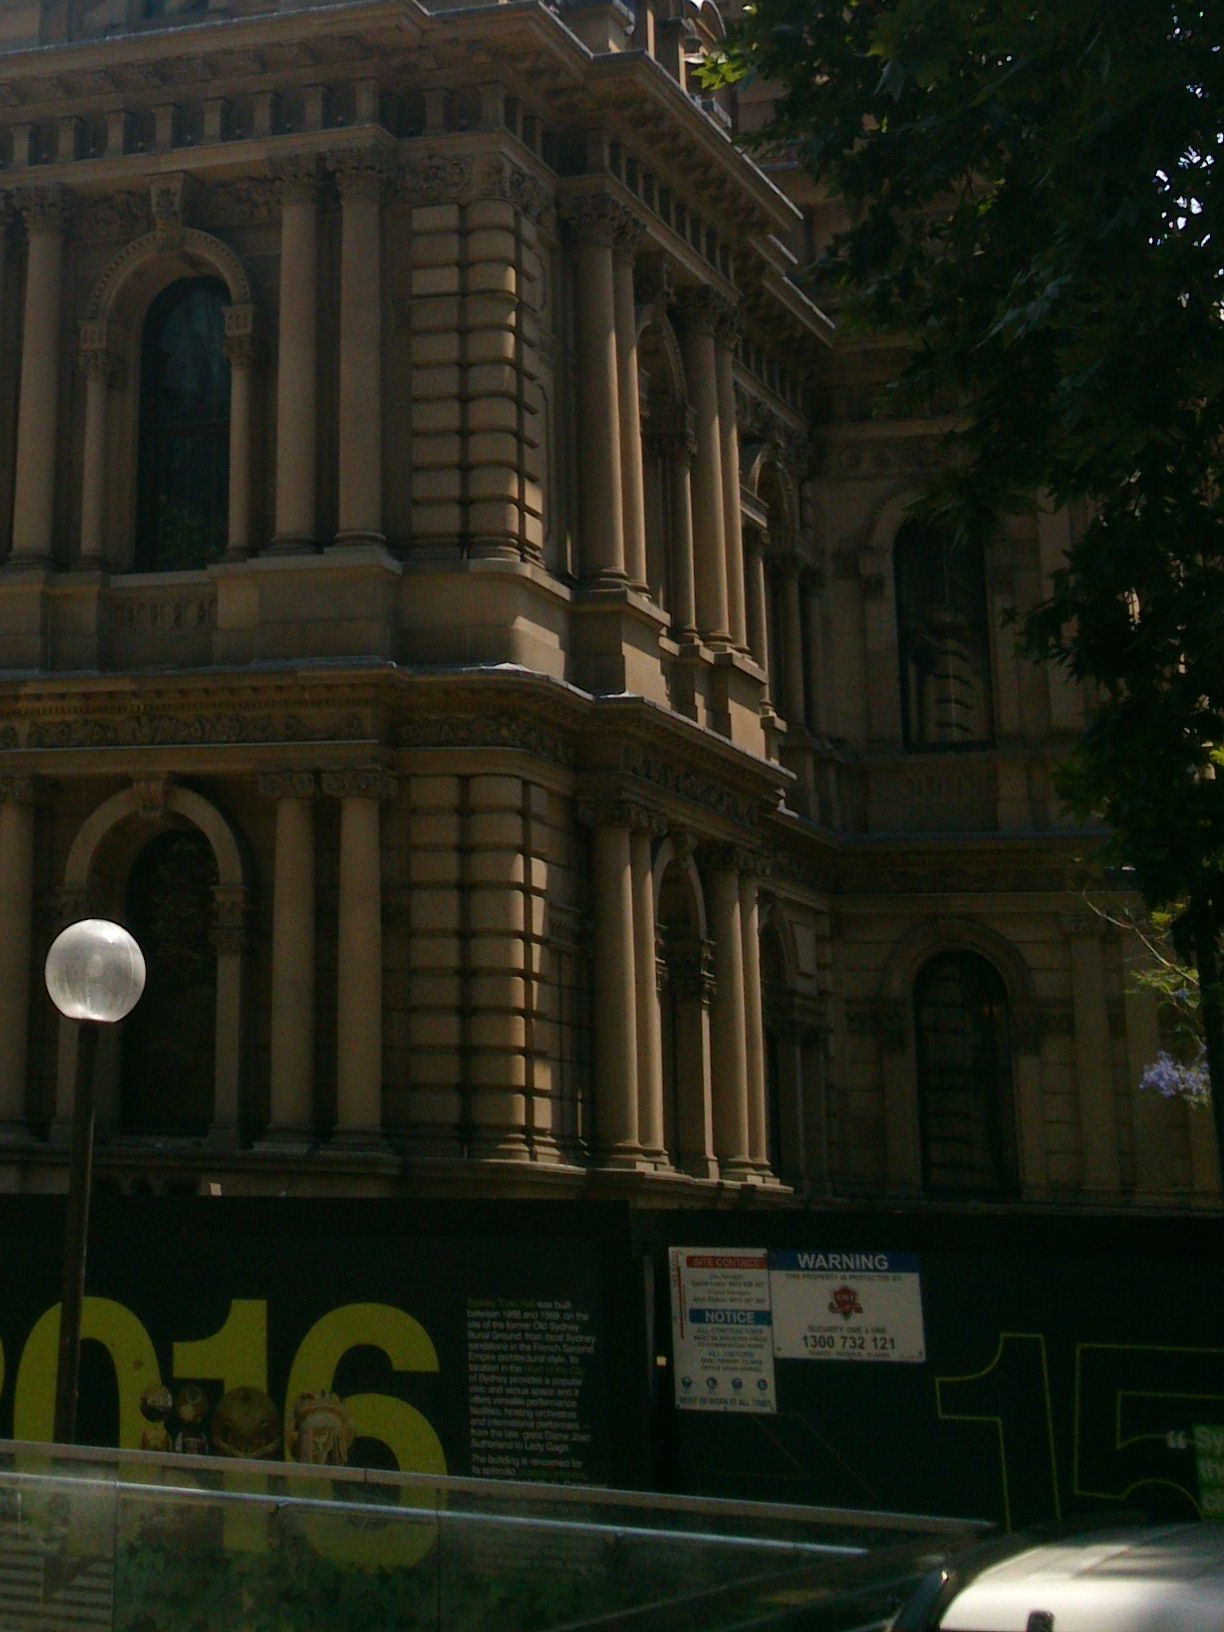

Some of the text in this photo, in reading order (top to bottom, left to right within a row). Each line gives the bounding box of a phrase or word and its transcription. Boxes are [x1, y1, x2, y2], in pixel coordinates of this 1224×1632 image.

[694, 1257, 713, 1266] SITE
[797, 1252, 889, 1271] WARNING
[537, 1301, 553, 1309] was
[554, 1299, 572, 1309] built
[467, 1309, 501, 1318] between
[523, 1310, 539, 1319] and
[576, 1311, 589, 1321] the
[705, 1311, 755, 1324] NOTICE
[492, 1320, 505, 1329] the
[533, 1321, 548, 1331] Old
[549, 1321, 579, 1333] Sydney
[565, 1333, 596, 1345] Sydney
[801, 1334, 895, 1351] 1300 732 121
